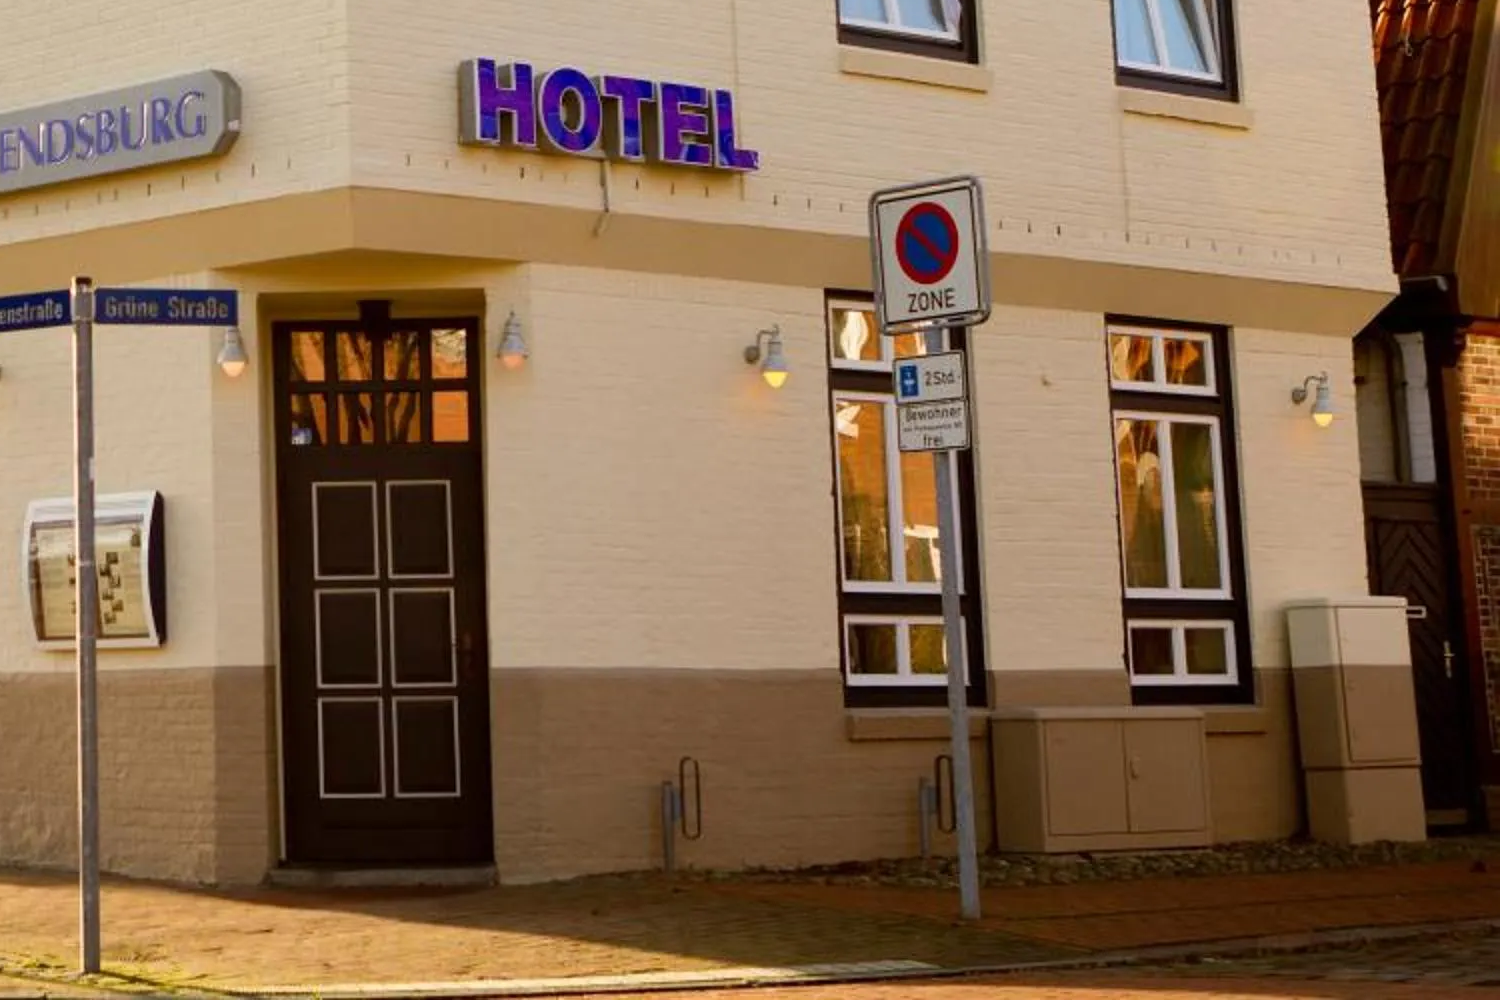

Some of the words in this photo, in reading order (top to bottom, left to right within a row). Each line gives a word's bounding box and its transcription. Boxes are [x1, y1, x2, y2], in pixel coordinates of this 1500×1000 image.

[473, 57, 759, 171] HOTEL
[104, 296, 159, 319] Grüne
[167, 296, 230, 319] Straße
[908, 289, 956, 313] ZONE
